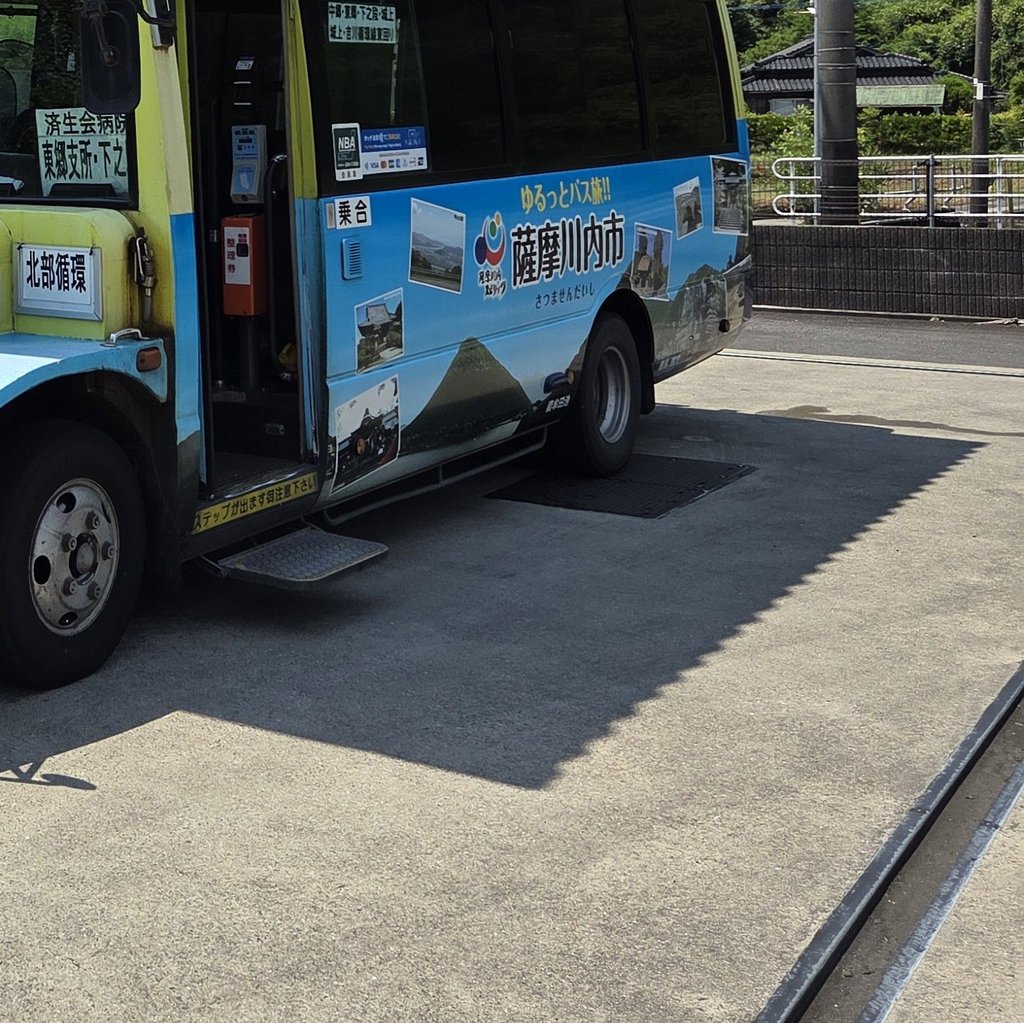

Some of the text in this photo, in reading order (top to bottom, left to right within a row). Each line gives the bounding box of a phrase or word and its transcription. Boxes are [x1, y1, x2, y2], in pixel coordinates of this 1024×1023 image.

[338, 136, 356, 149] NBA
[338, 199, 368, 226] 乗合
[511, 210, 625, 288] 薩摩川内市
[26, 250, 87, 294] 北部循環
[535, 282, 595, 309] さつませんだいし
